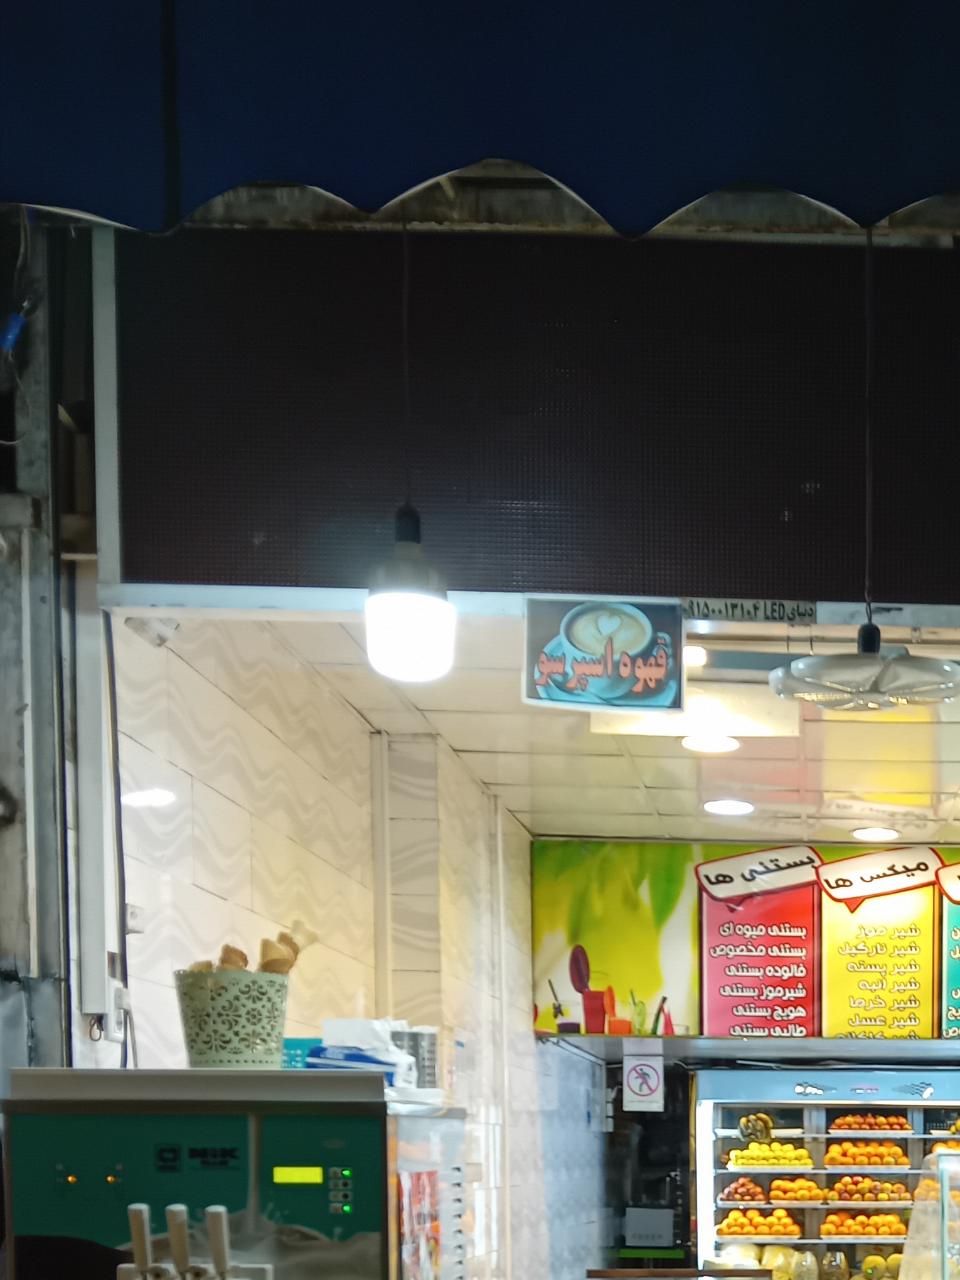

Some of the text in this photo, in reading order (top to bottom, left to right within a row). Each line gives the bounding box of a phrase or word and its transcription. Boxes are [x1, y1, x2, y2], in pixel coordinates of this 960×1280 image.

[764, 601, 785, 620] LED
[619, 637, 668, 693] قهوه
[704, 855, 817, 885] بستنی ها
[824, 862, 929, 890] میکس ها
[720, 922, 806, 939] بستنی میوه ای
[856, 923, 920, 940] شیر موز
[710, 942, 806, 960] بستنی مخصوص
[889, 941, 920, 958] شیر
[725, 963, 806, 979] فالوده بستنی
[847, 959, 920, 978] شیر پسته
[720, 983, 759, 999] بستنی
[889, 977, 920, 993] شیر
[849, 994, 920, 1011] شیر خرما
[732, 1003, 806, 1021] هویج بستنی
[848, 1012, 920, 1029] شیر عسل
